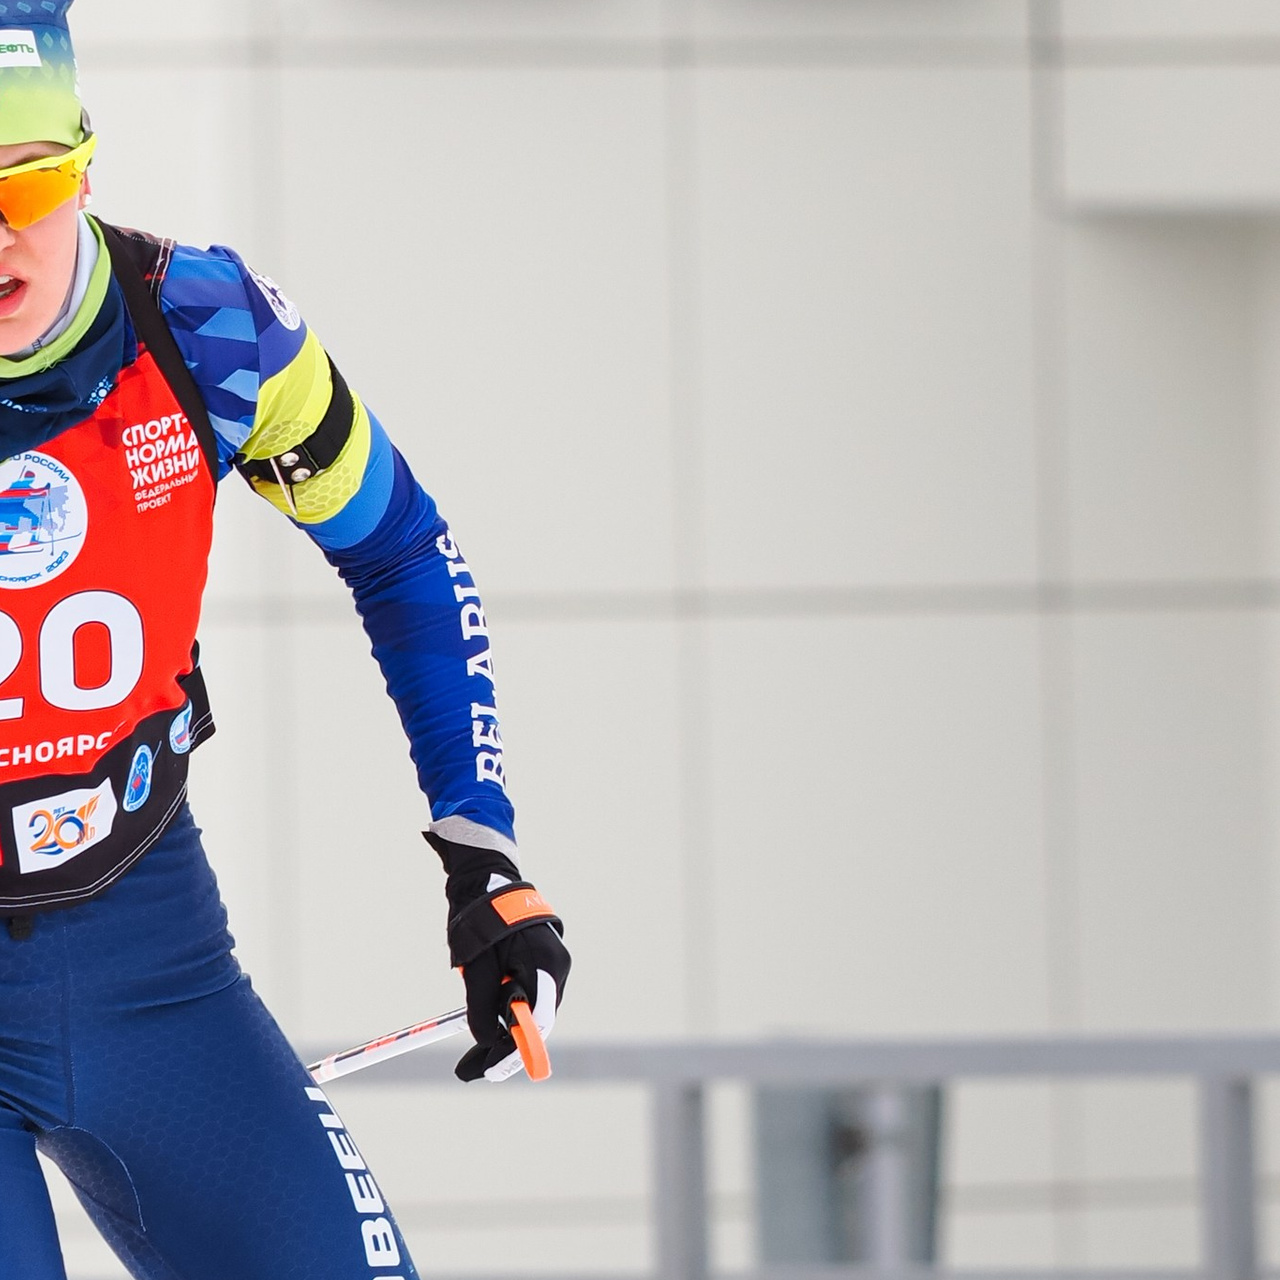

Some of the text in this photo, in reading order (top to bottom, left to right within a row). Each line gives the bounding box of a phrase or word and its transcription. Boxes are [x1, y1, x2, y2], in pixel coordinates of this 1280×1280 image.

[125, 429, 199, 470] НОРМА
[23, 453, 70, 483] РОССИИ
[129, 447, 200, 490] ЖИЗНИ
[133, 467, 199, 502] ФЕДЕРАЛЬНЫ
[136, 492, 172, 514] ПРОЕКТ
[44, 549, 70, 573] 2023
